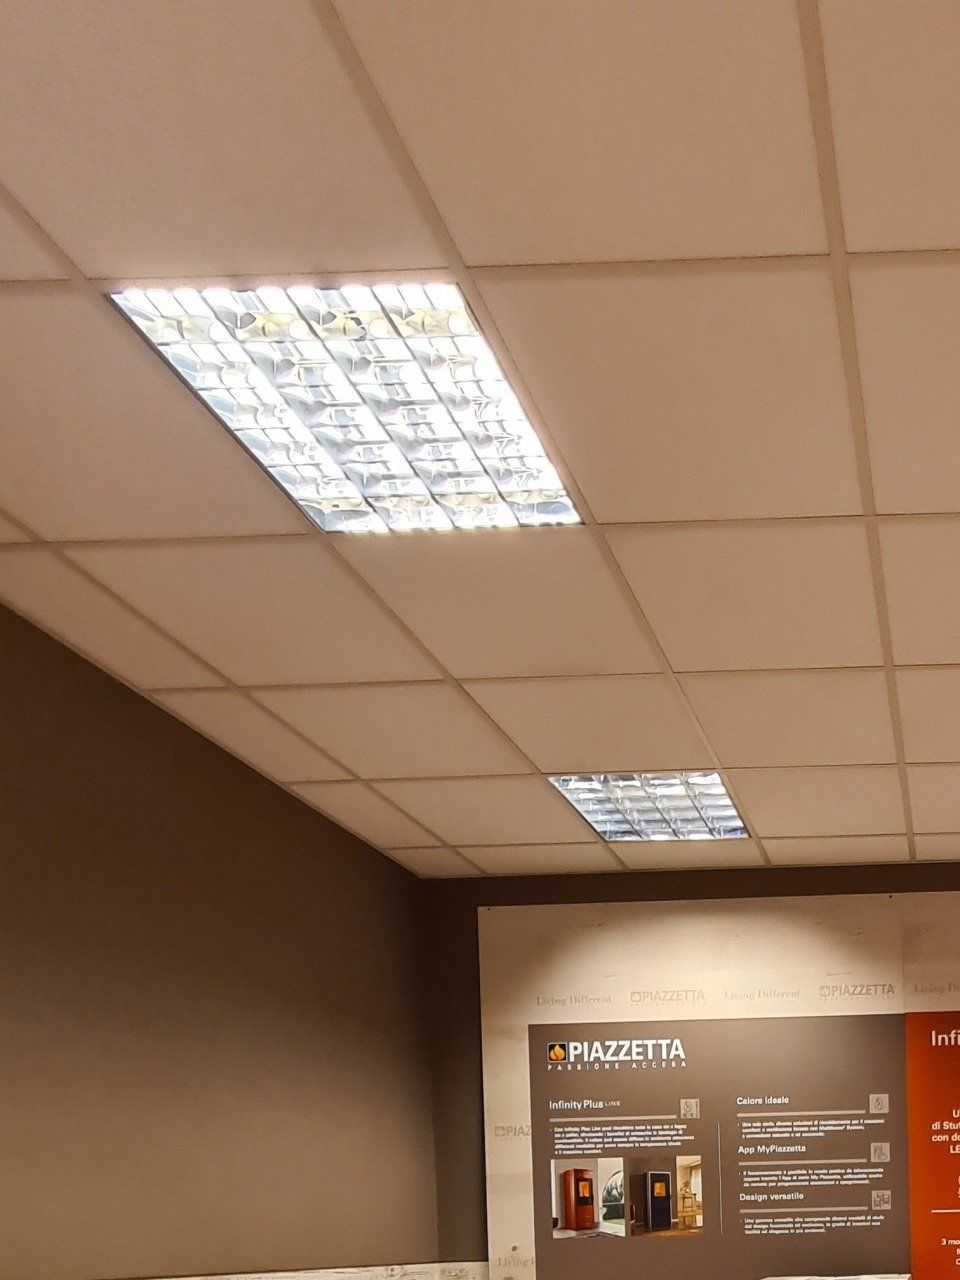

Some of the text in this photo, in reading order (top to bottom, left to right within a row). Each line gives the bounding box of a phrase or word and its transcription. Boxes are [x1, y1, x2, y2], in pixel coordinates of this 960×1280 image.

[831, 983, 895, 996] PIAZZETTA
[537, 993, 611, 1006] Living Different
[641, 989, 705, 1002] PIAZZETTA
[569, 1039, 686, 1062] PIAZZETTA
[547, 1061, 687, 1071] PASSIONE ACCESA
[549, 1100, 582, 1110] Infinity
[583, 1099, 604, 1109] Plus
[737, 1096, 763, 1105] Calore
[932, 1121, 940, 1130] di
[932, 1133, 949, 1141] con
[738, 1144, 806, 1155] App MyPiazzetta
[739, 1191, 804, 1202] Design versatile
